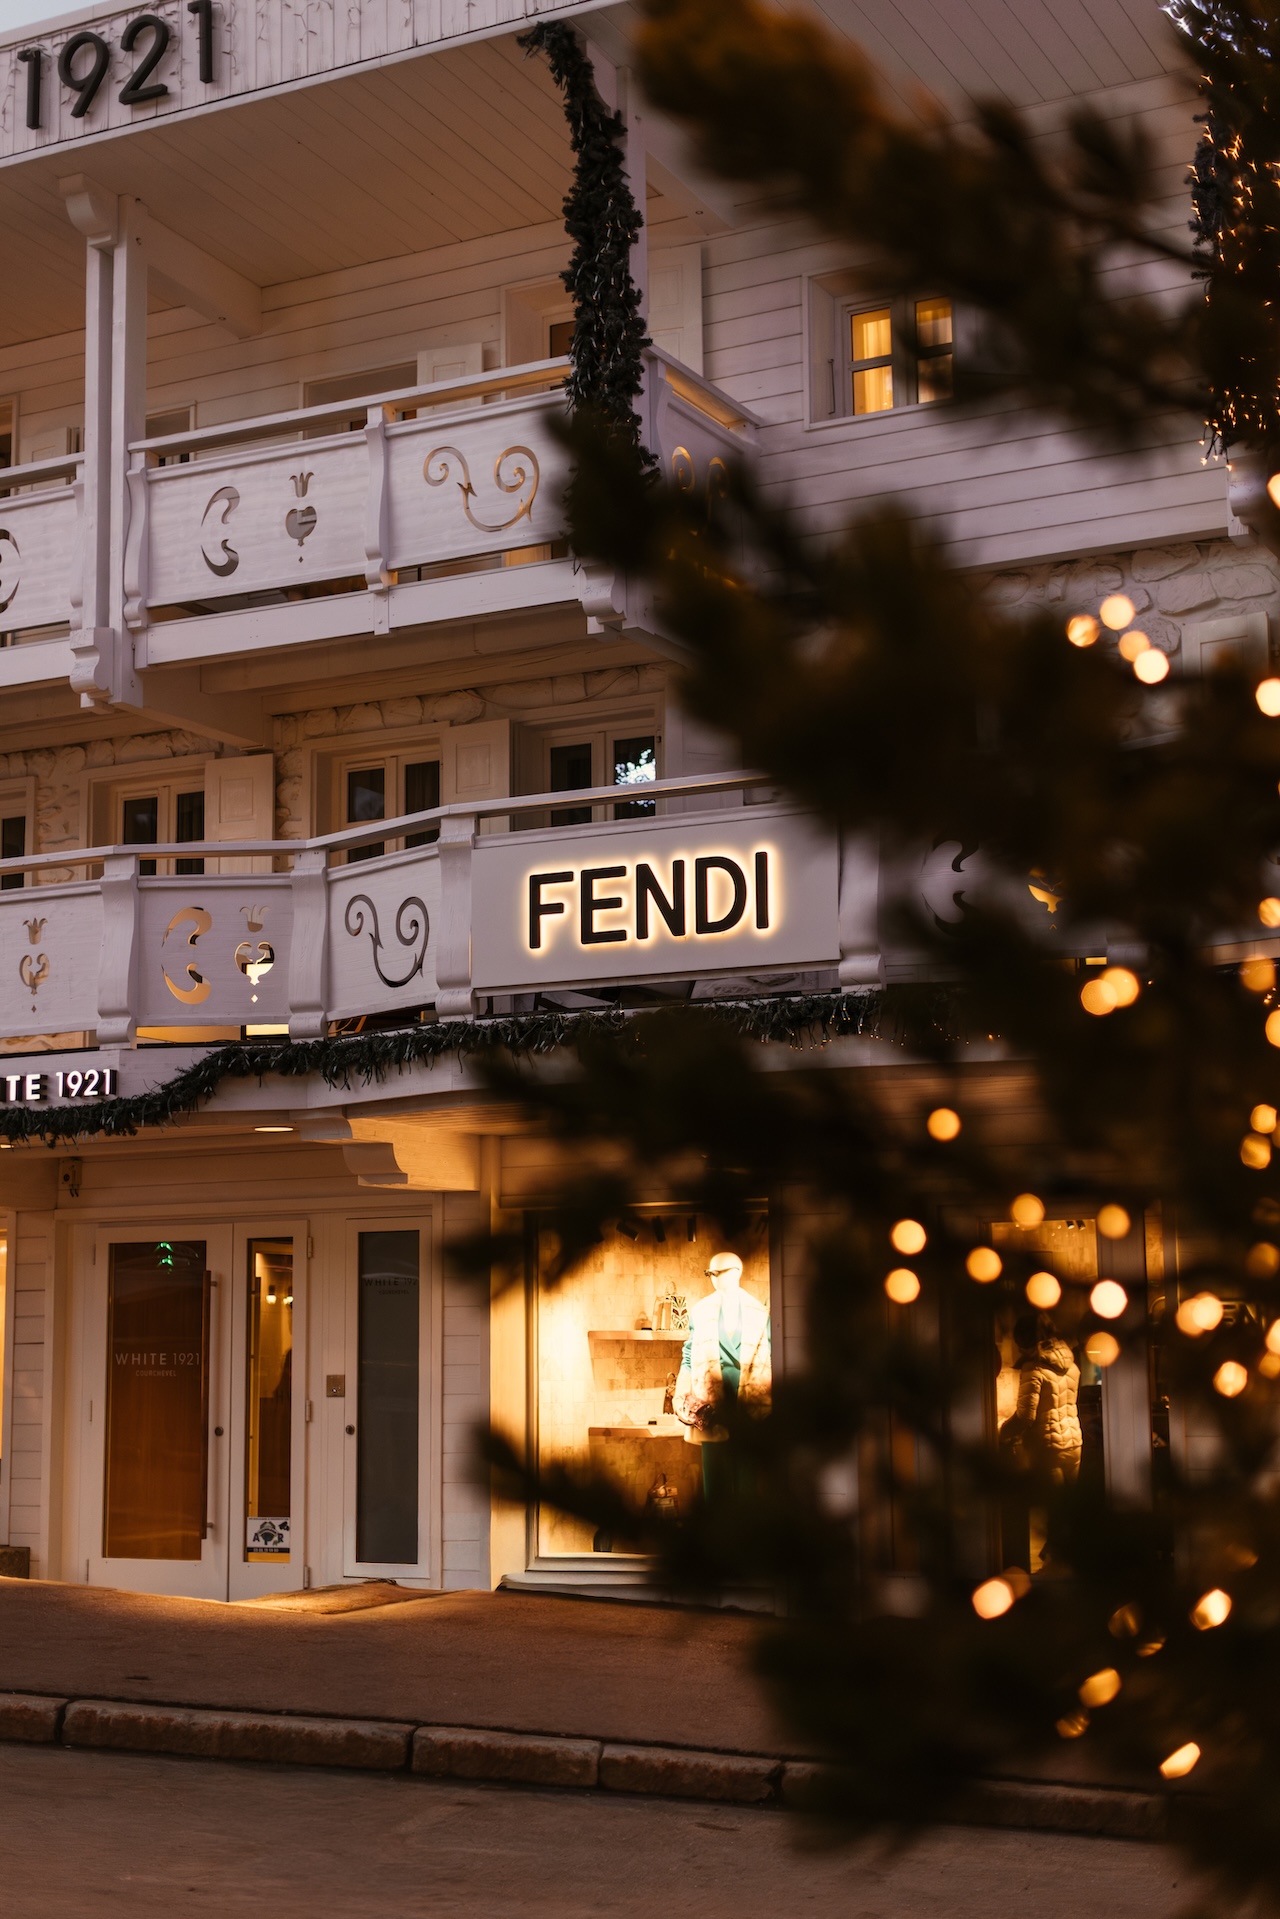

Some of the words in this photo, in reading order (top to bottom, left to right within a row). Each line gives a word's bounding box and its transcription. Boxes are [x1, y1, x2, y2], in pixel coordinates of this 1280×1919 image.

[17, 0, 213, 129] 1921
[529, 851, 769, 949] FENDI
[56, 1069, 110, 1097] 1921
[115, 1352, 167, 1365] WHITE
[172, 1352, 200, 1365] 1921
